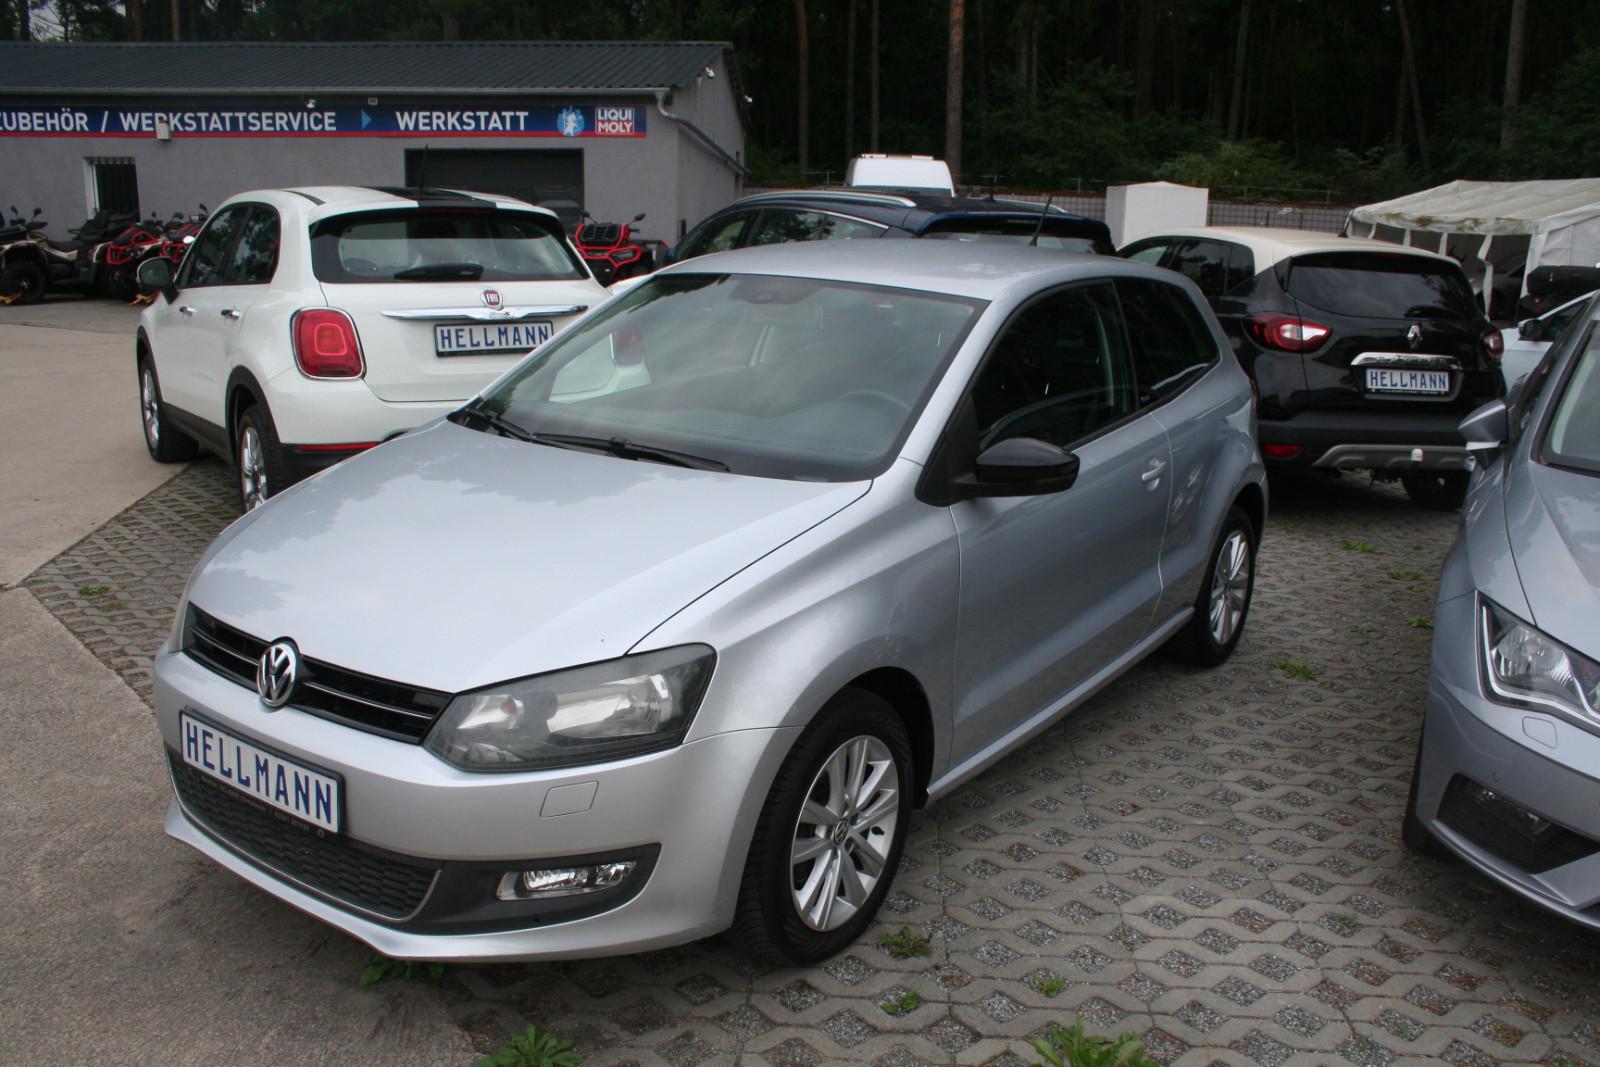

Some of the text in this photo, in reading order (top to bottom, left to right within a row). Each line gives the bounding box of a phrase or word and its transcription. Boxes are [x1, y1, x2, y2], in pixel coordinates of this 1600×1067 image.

[0, 107, 88, 131] UBEHÖR
[101, 111, 108, 132] /
[396, 111, 528, 131] WERKSTATT
[598, 109, 632, 121] LIQUI
[597, 121, 632, 133] MOLY
[440, 326, 549, 348] HELLMANN
[1370, 371, 1446, 388] HELLMANN
[187, 721, 331, 824] HELLMANN
